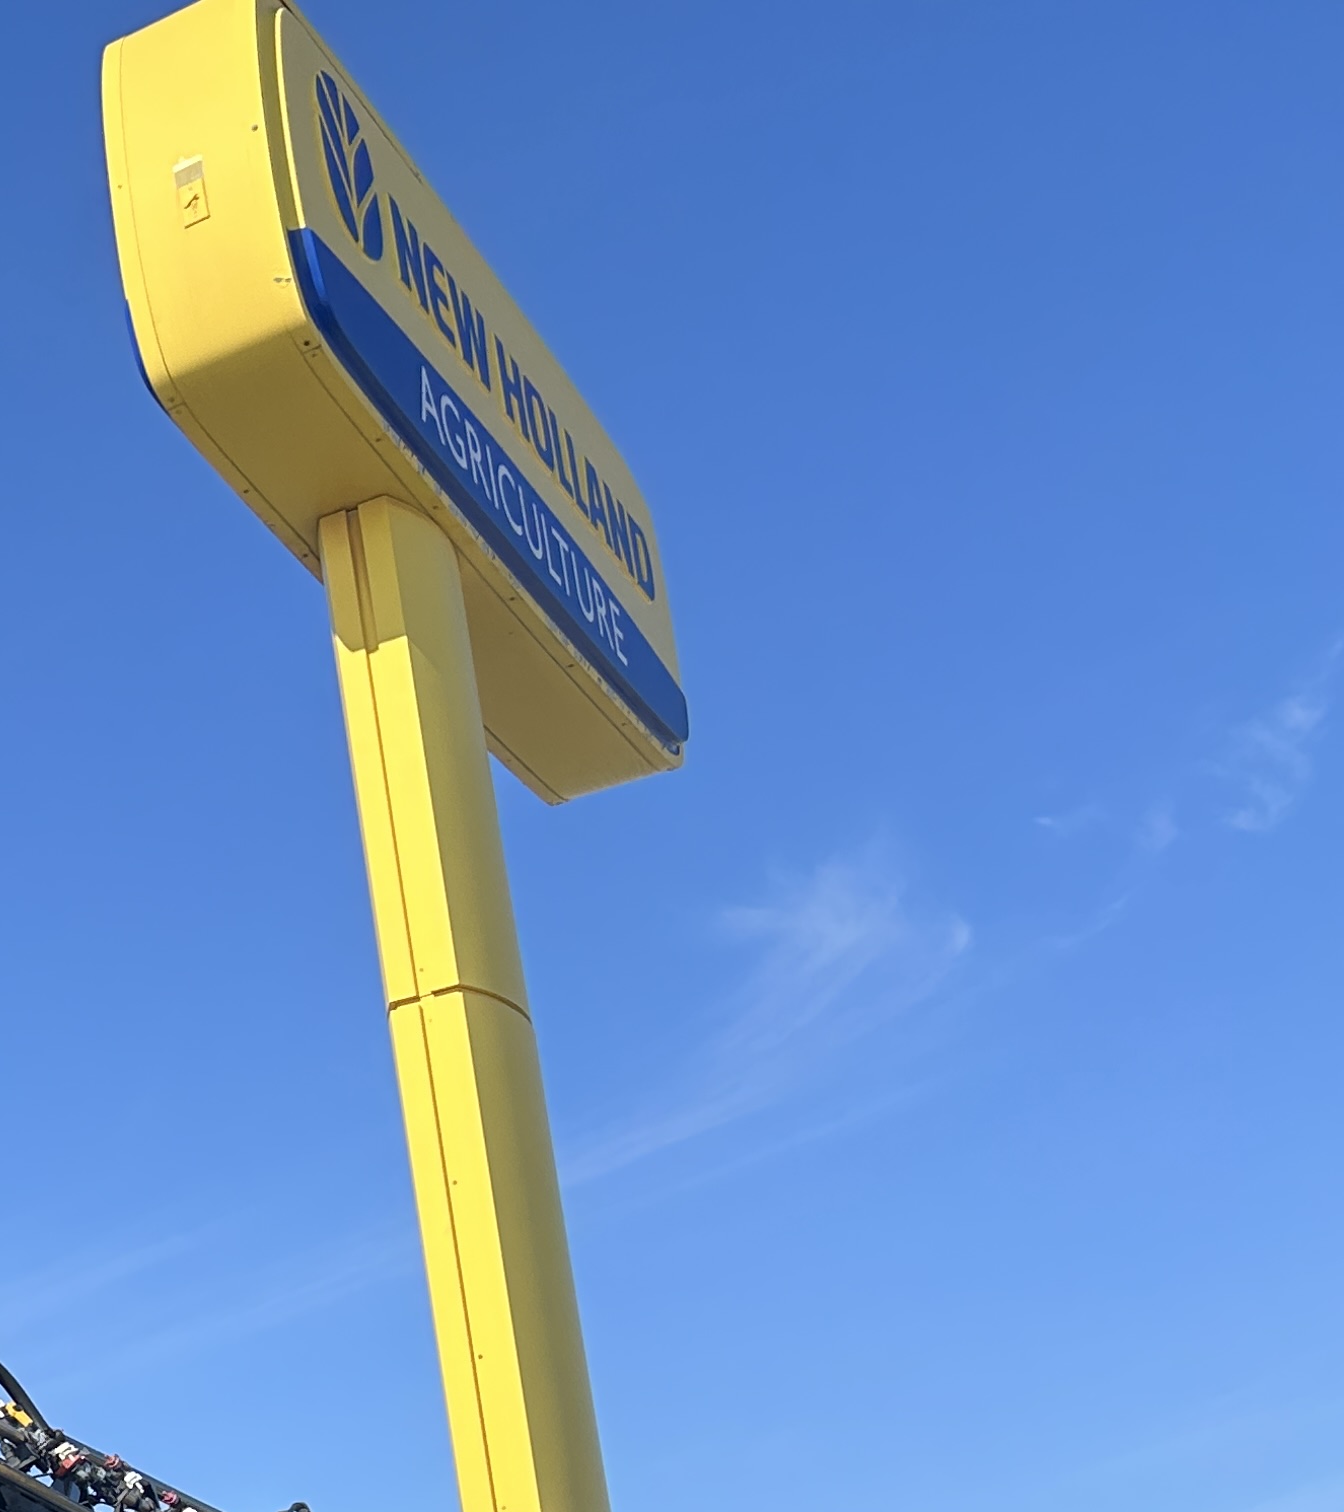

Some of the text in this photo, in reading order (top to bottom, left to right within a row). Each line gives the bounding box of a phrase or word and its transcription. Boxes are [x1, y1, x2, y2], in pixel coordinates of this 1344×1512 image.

[387, 193, 655, 602] NEW HOLLAND
[420, 365, 628, 666] AGRICULTURE
